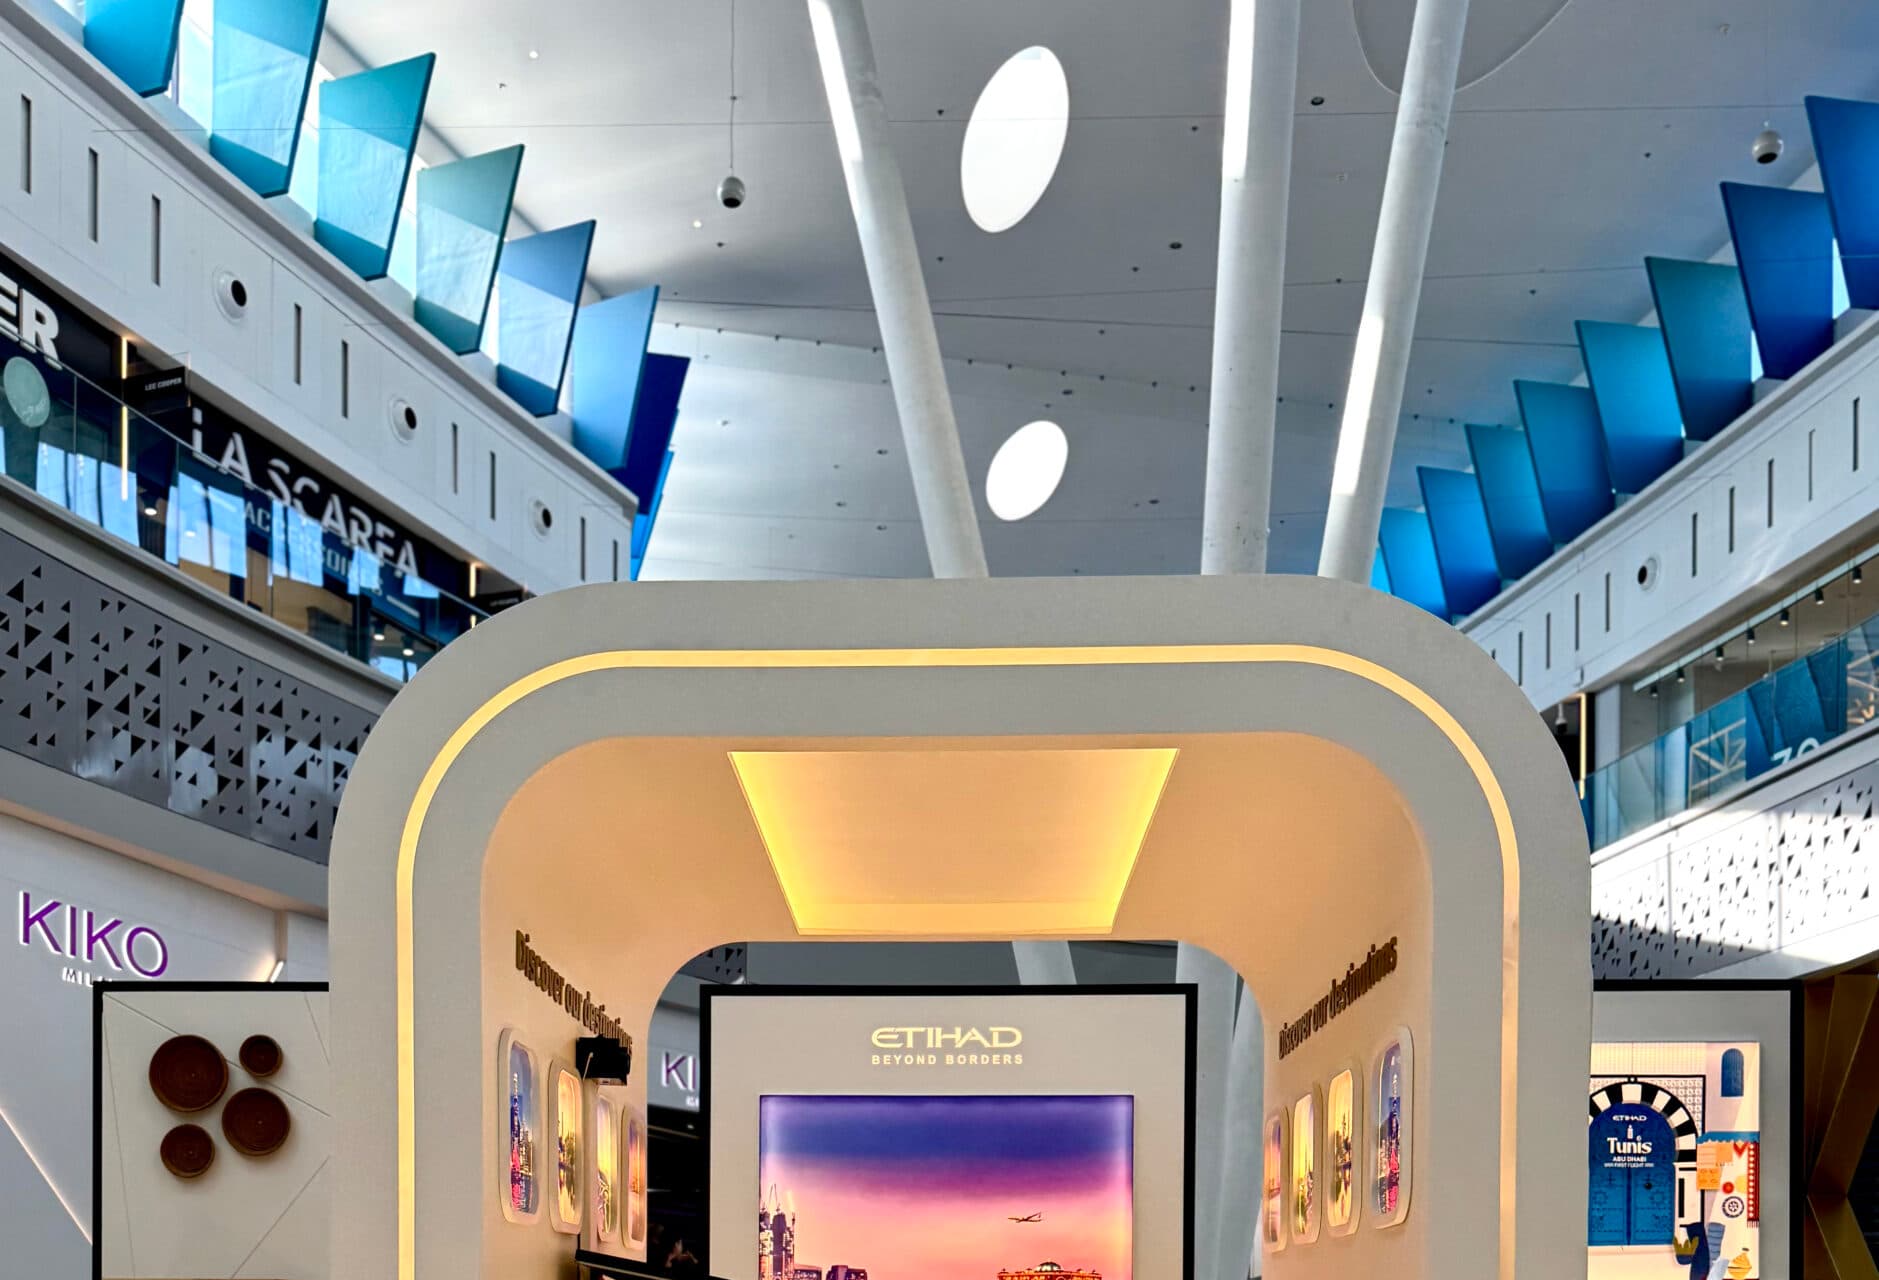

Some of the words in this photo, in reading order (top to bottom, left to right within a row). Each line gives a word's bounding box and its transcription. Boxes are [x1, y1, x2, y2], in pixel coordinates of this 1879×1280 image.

[192, 408, 254, 490] LA
[19, 890, 168, 979] KIKO
[516, 929, 565, 1006] Discover
[564, 983, 582, 1022] our
[871, 1026, 1023, 1049] ETIHAD
[1279, 1008, 1313, 1060] Discover
[1312, 994, 1329, 1032] our
[1329, 936, 1398, 1019] destinations
[871, 1054, 937, 1065] BEYOND
[945, 1054, 1023, 1065] BORDERS
[1606, 1135, 1653, 1154] Tunis
